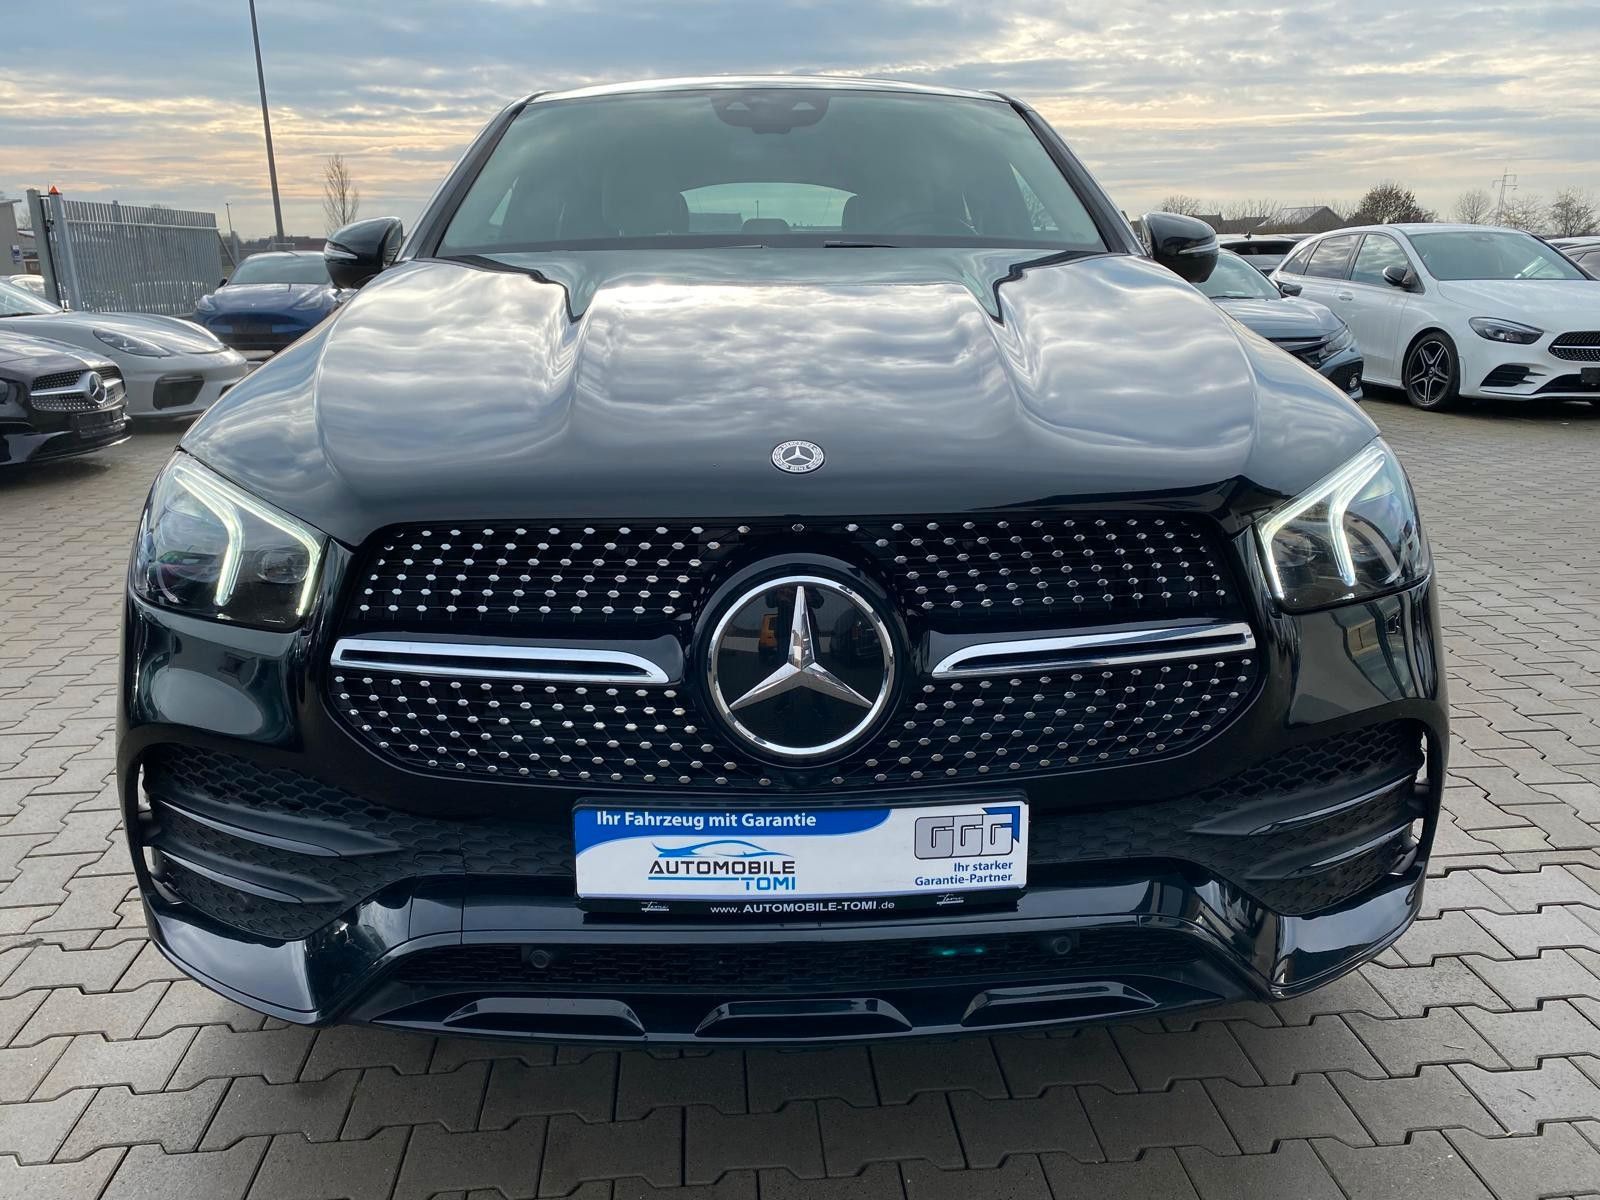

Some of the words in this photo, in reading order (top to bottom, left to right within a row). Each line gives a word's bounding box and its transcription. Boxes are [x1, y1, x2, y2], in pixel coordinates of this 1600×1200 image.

[597, 811, 621, 826] Ihr
[625, 811, 704, 831] Fahrzeug
[708, 813, 738, 827] mit
[741, 812, 817, 827] Garantie
[648, 860, 796, 875] AUTOMOBILE
[953, 862, 970, 872] Ihr
[972, 860, 1014, 872] starker
[741, 876, 796, 891] TOMI
[914, 873, 1013, 886] Garantie-Partner
